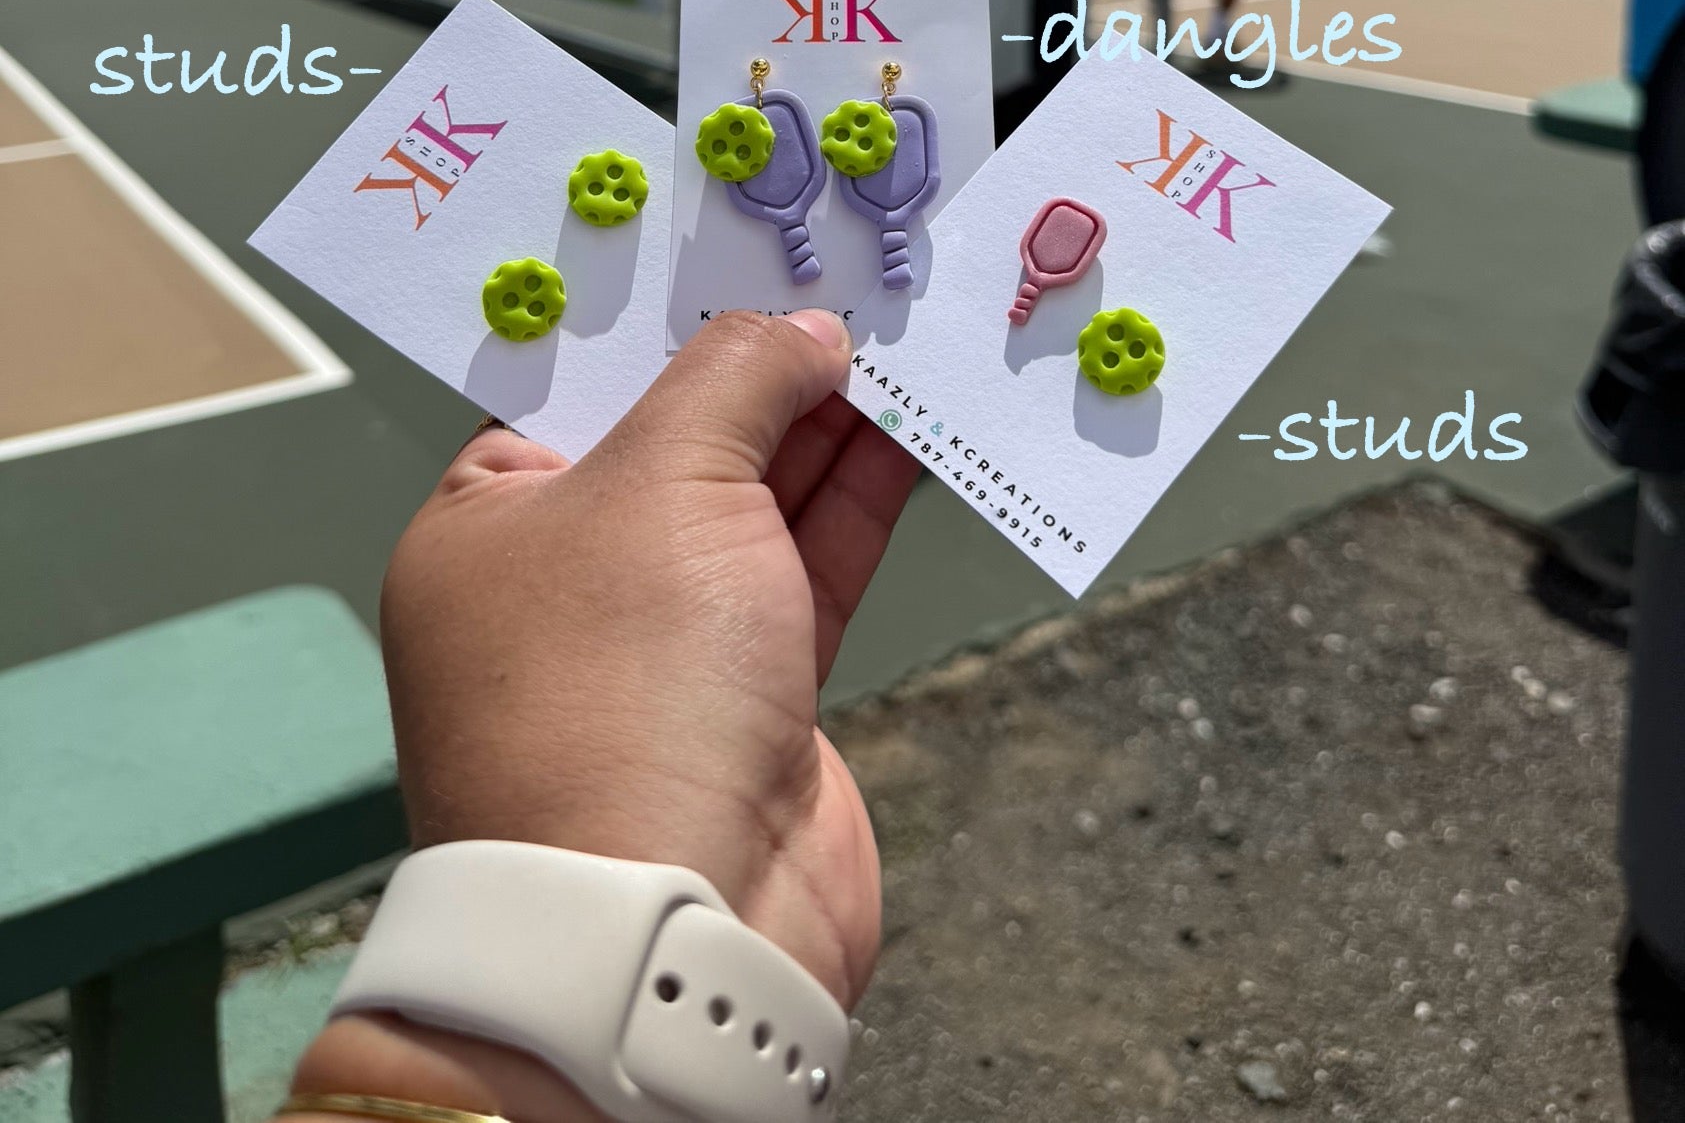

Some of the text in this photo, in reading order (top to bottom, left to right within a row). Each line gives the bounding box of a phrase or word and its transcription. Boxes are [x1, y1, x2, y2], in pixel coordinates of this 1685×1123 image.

[405, 136, 461, 178] SHOP
[1171, 149, 1216, 199] SHOP
[852, 354, 1087, 554] KAAZLY & KCREATIONS
[909, 432, 1043, 548] 787-469-9915
